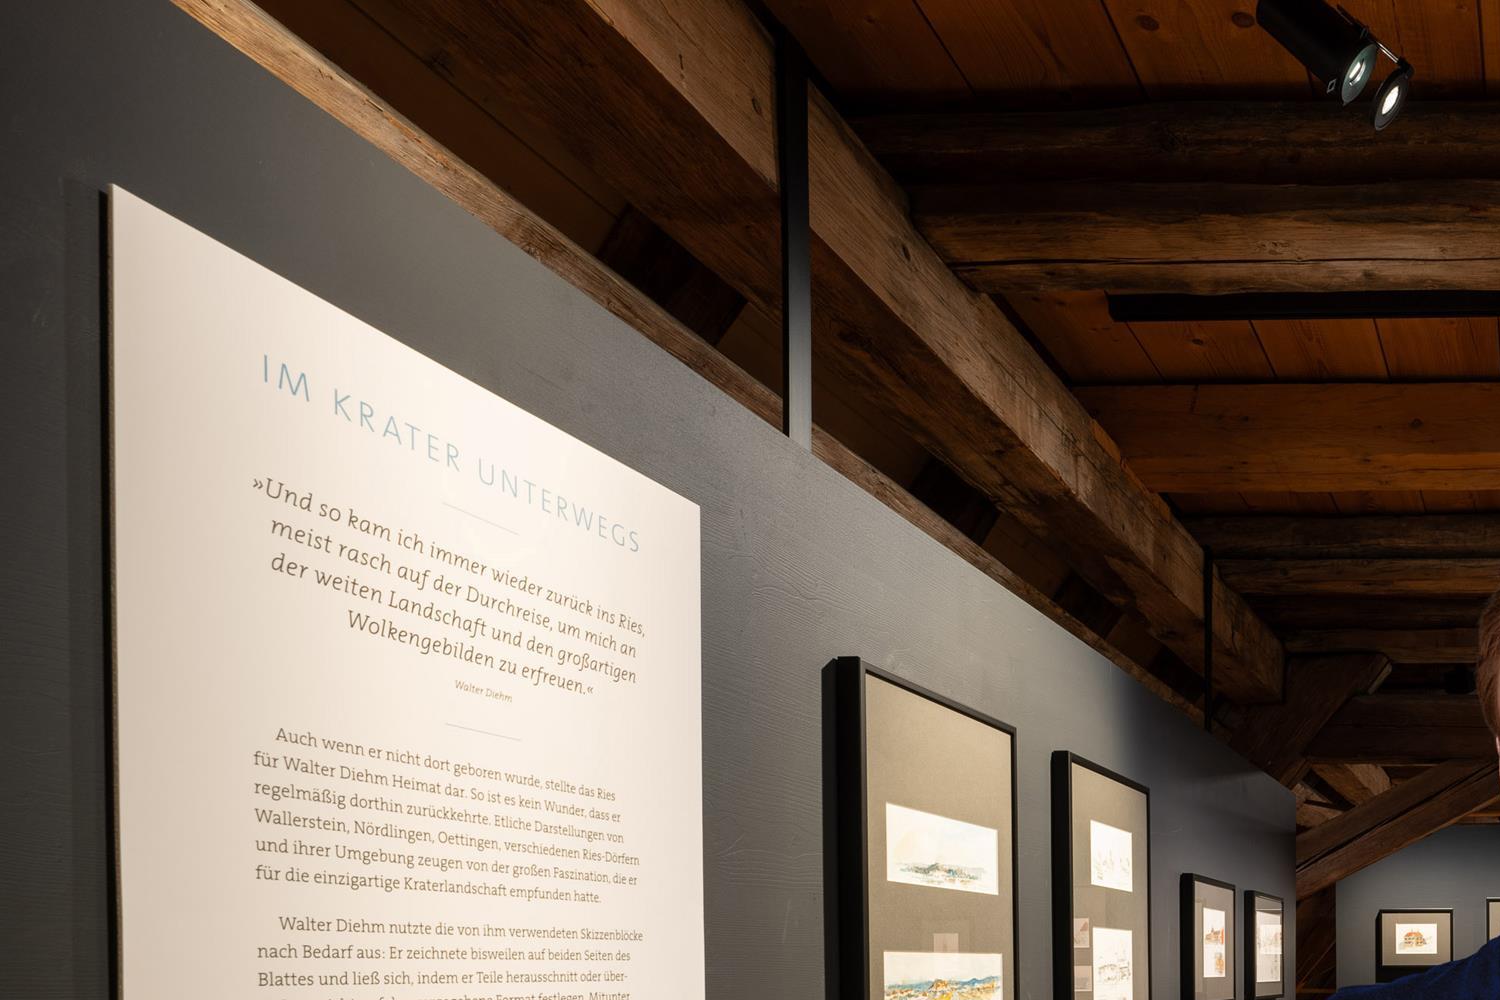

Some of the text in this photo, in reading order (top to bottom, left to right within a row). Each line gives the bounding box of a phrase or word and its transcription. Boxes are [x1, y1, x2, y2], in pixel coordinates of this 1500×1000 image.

[263, 354, 640, 553] IM KRATER UNTERWEGS
[252, 477, 645, 638] »Und so kam ich immer wieder zurück ins Ries,
[271, 519, 637, 659] meist rasch auf der Durchreise, um mich an
[271, 552, 636, 684] der weiten Landschaft und den großartigen
[347, 609, 594, 695] Wolkengebilden zu erfreuen.«
[454, 679, 513, 703] Walter Diehm
[253, 750, 517, 807] für Walter Diehm Heimat dar. So ist es
[275, 727, 543, 790] Auch wenn er nicht dort geboren wurde,
[254, 782, 532, 832] regelmäßig dorthin zurückkehrte. Etliche
[254, 807, 581, 860] Wallerstein, Nördlingen, Oettingen, verschiedenen
[255, 838, 552, 879] und ihrer Umgebung zeugen von der großen
[255, 864, 572, 902] für die einzigartige Kraterlandschaft empfunden
[257, 943, 526, 961] nach Bedarf aus: Er zeichnete bisweilen
[278, 916, 579, 940] Walter Diehm nutzte die von ihm verwendeten
[257, 970, 579, 987] Blattes und ließ sich, indem er Teile herausschnitt
